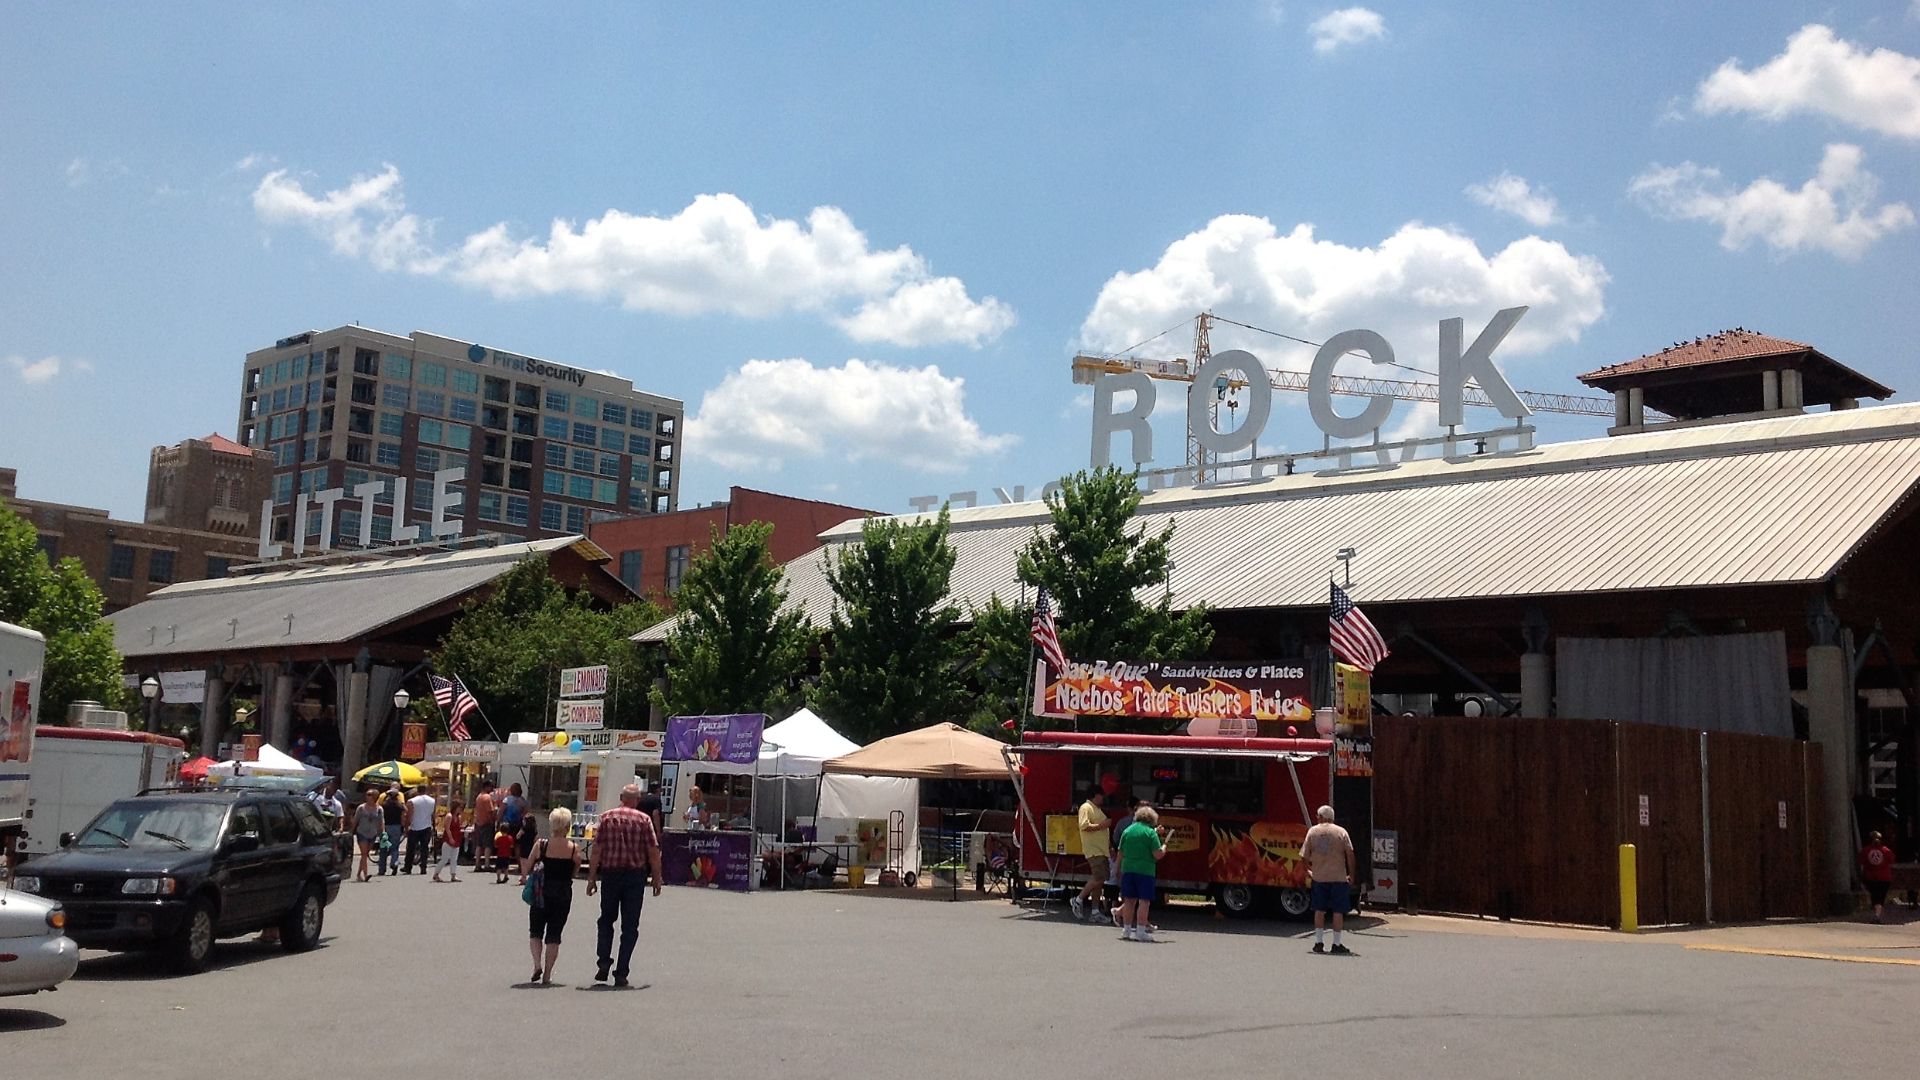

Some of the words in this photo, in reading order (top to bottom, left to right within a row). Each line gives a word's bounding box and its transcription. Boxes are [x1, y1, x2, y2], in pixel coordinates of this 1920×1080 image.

[1090, 305, 1532, 470] ROCK
[258, 467, 465, 558] LITTLE
[574, 668, 607, 693] LEMONADE
[1161, 666, 1242, 679] Sandwiches
[1245, 667, 1258, 679] &
[1260, 665, 1304, 679] Plates
[1056, 683, 1123, 711] Nachos
[1133, 686, 1171, 713] Tater
[1176, 687, 1242, 715] Twisters
[1250, 688, 1304, 717] Fries
[571, 706, 587, 723] CORN
[588, 706, 601, 722] DOGS
[593, 732, 611, 745] CAKES
